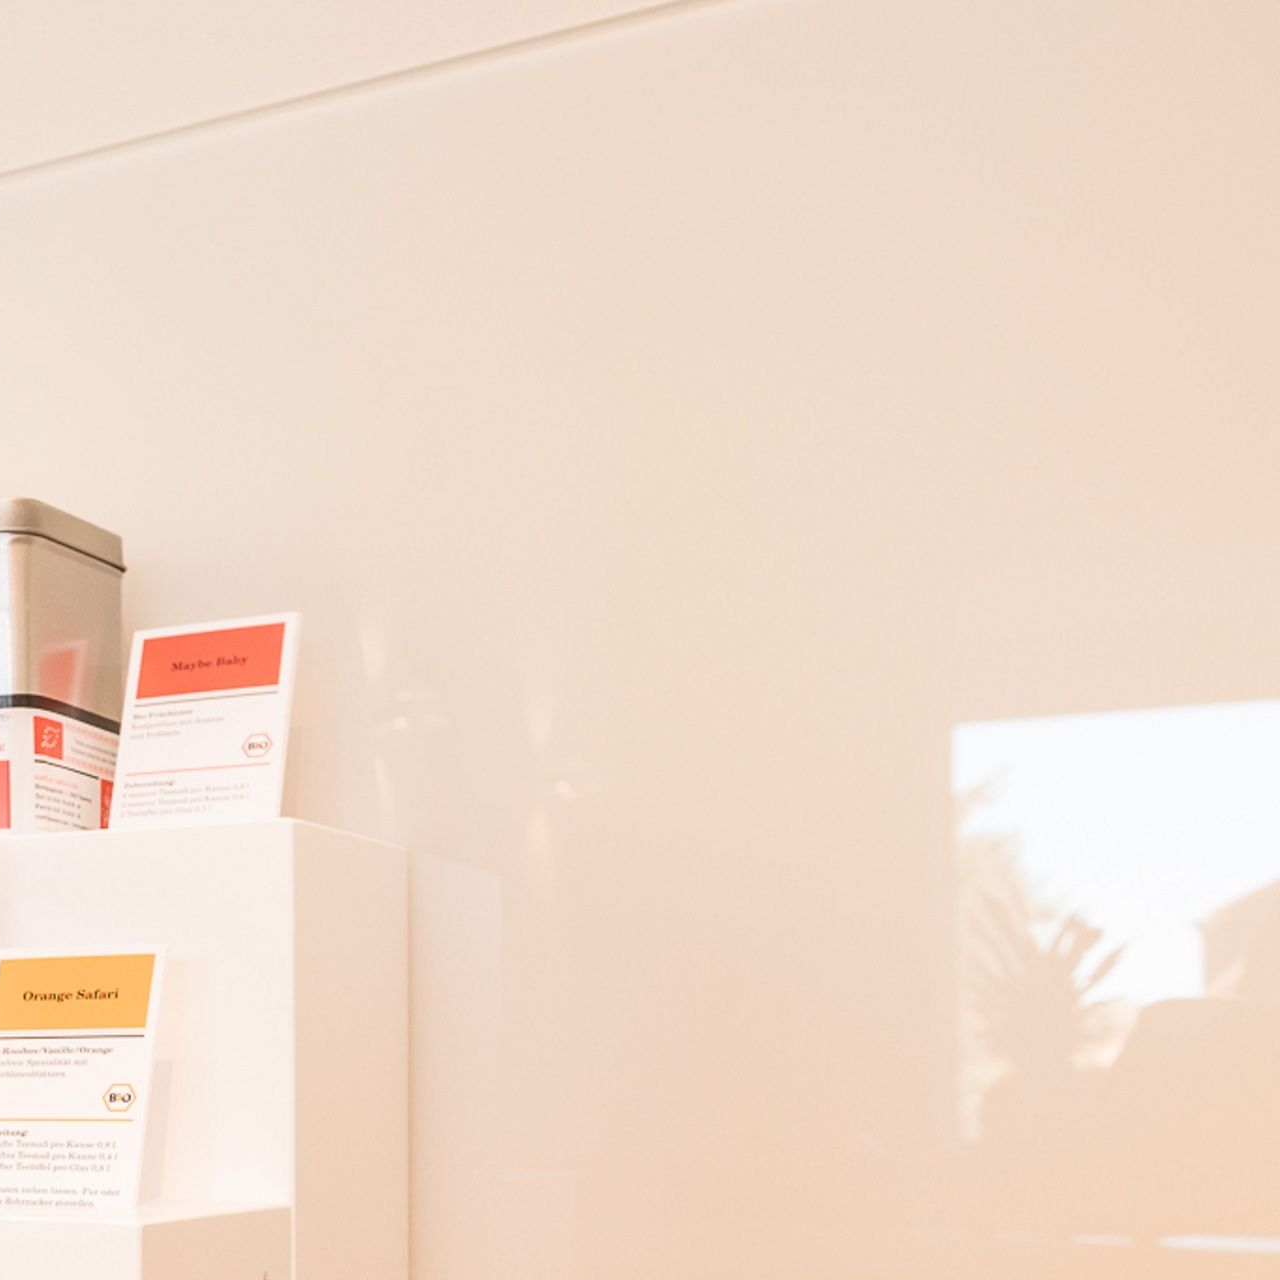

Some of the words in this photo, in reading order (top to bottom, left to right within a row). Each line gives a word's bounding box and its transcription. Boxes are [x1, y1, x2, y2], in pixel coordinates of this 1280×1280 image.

[171, 659, 212, 672] Maybe
[216, 655, 249, 668] Baby
[22, 988, 73, 1003] Orange
[75, 987, 119, 1001] Safari
[108, 1092, 132, 1104] BIO
